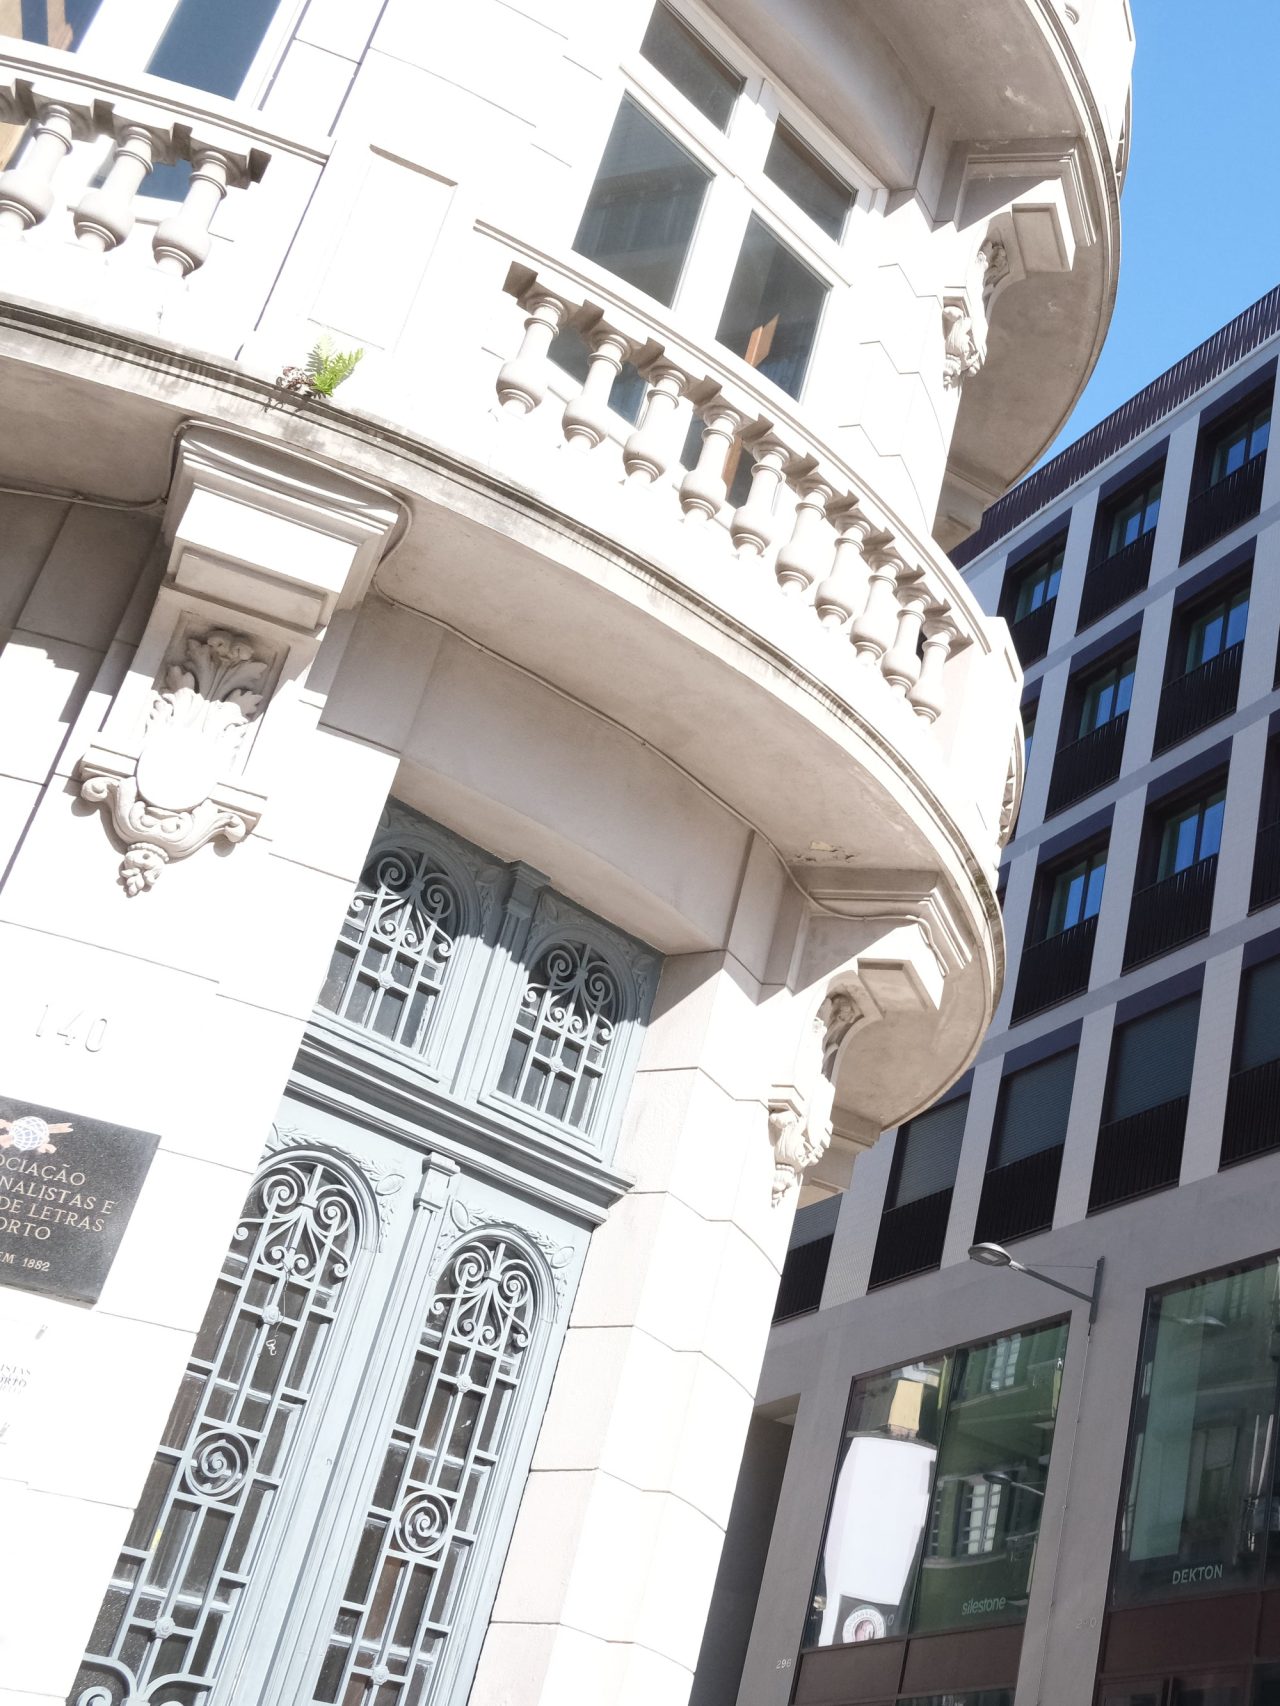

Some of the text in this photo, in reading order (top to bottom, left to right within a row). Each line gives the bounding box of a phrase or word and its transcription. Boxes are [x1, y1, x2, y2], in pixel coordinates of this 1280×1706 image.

[35, 1004, 108, 1052] 140
[100, 1200, 115, 1214] E
[28, 1202, 105, 1232] LETRAS
[22, 1257, 50, 1272] 1882
[1172, 1564, 1223, 1585] DEKTON
[961, 1597, 1007, 1616] silestone
[776, 1658, 791, 1670] 296
